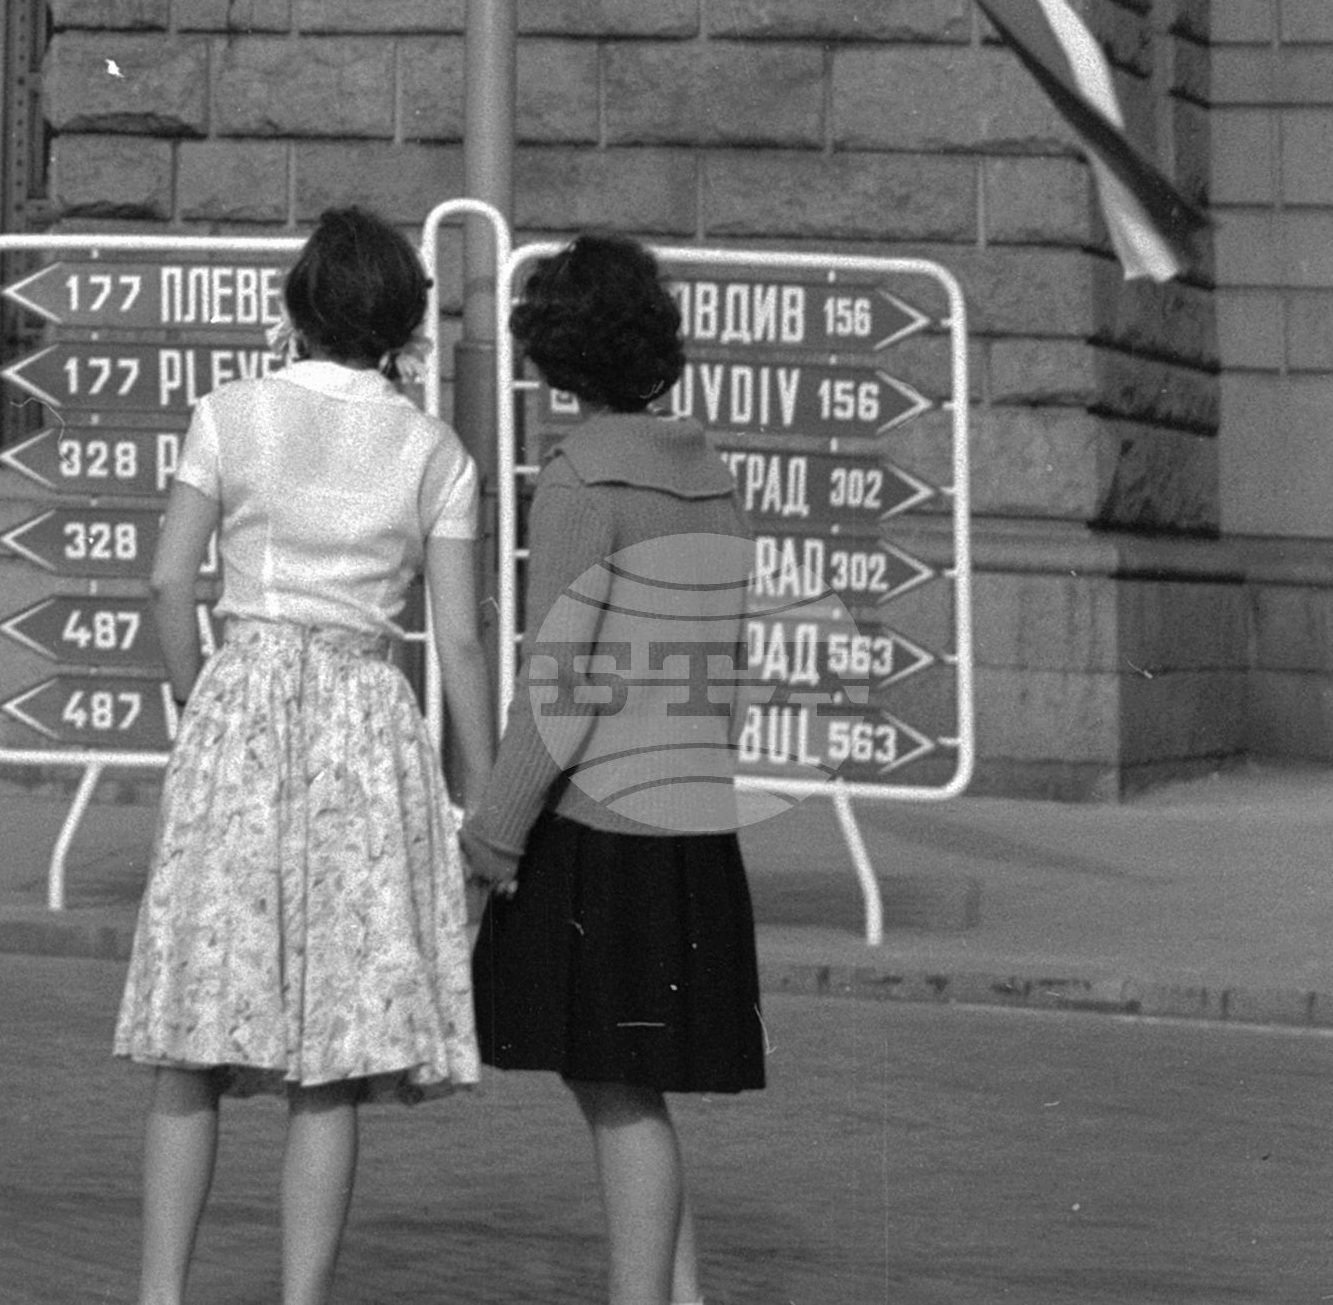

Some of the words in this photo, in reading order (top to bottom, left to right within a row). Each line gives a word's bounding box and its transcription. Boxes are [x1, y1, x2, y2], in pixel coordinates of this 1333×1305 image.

[65, 274, 143, 313] 177
[159, 266, 283, 325] ПЛЕВЕ
[669, 281, 806, 344] ОВДИВ
[823, 296, 873, 337] 156
[63, 356, 141, 396] 177
[670, 363, 801, 427] OVDIV
[817, 378, 881, 422] 156
[58, 439, 138, 478] 328
[720, 452, 810, 517] ГРАД
[830, 468, 884, 508] 302
[63, 521, 138, 560] 328
[748, 535, 825, 597] RAD
[830, 551, 889, 591] 302
[62, 609, 141, 651] 487
[747, 621, 821, 687] РАД
[827, 633, 894, 676] 563
[62, 690, 142, 730] 487
[738, 704, 821, 766] BUL
[827, 720, 897, 763] 563
